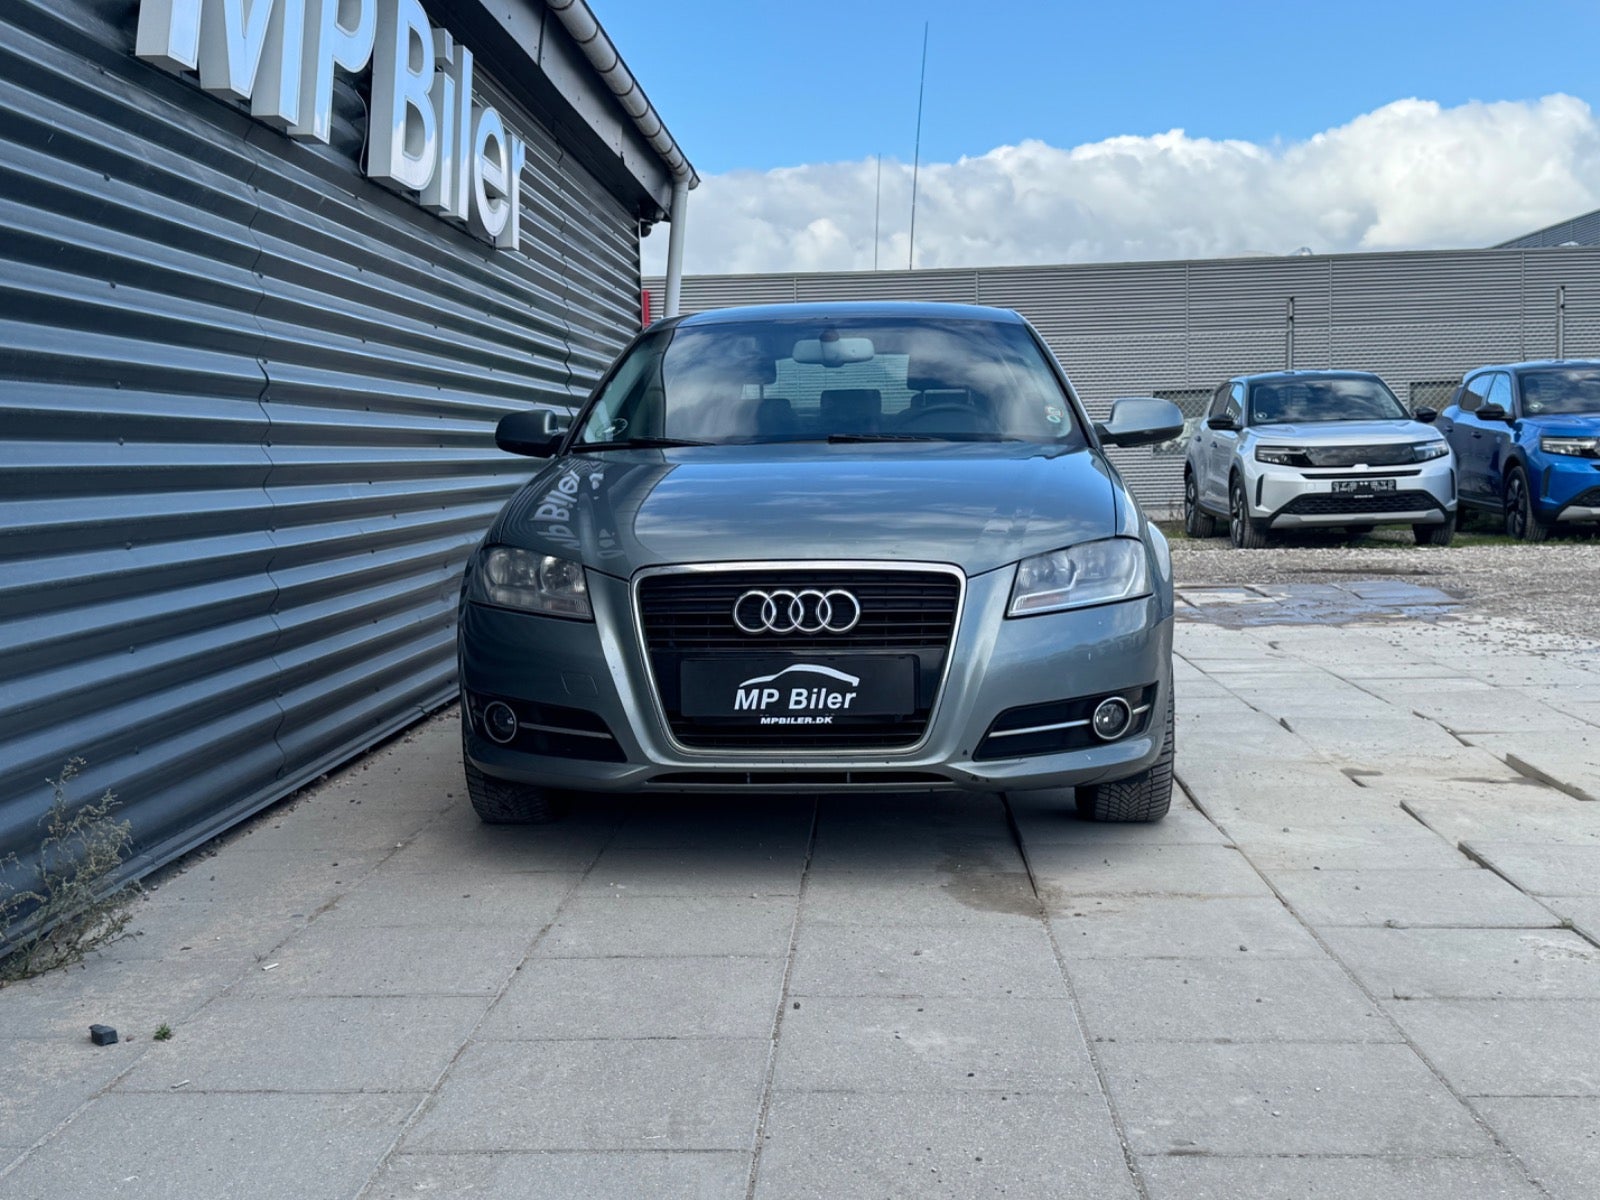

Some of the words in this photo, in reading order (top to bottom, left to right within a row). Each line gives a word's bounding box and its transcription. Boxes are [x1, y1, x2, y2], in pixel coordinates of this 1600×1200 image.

[367, 0, 526, 251] Biler
[734, 688, 779, 710] MP
[788, 688, 856, 710] Biler
[760, 716, 833, 725] MPBILER.DK
